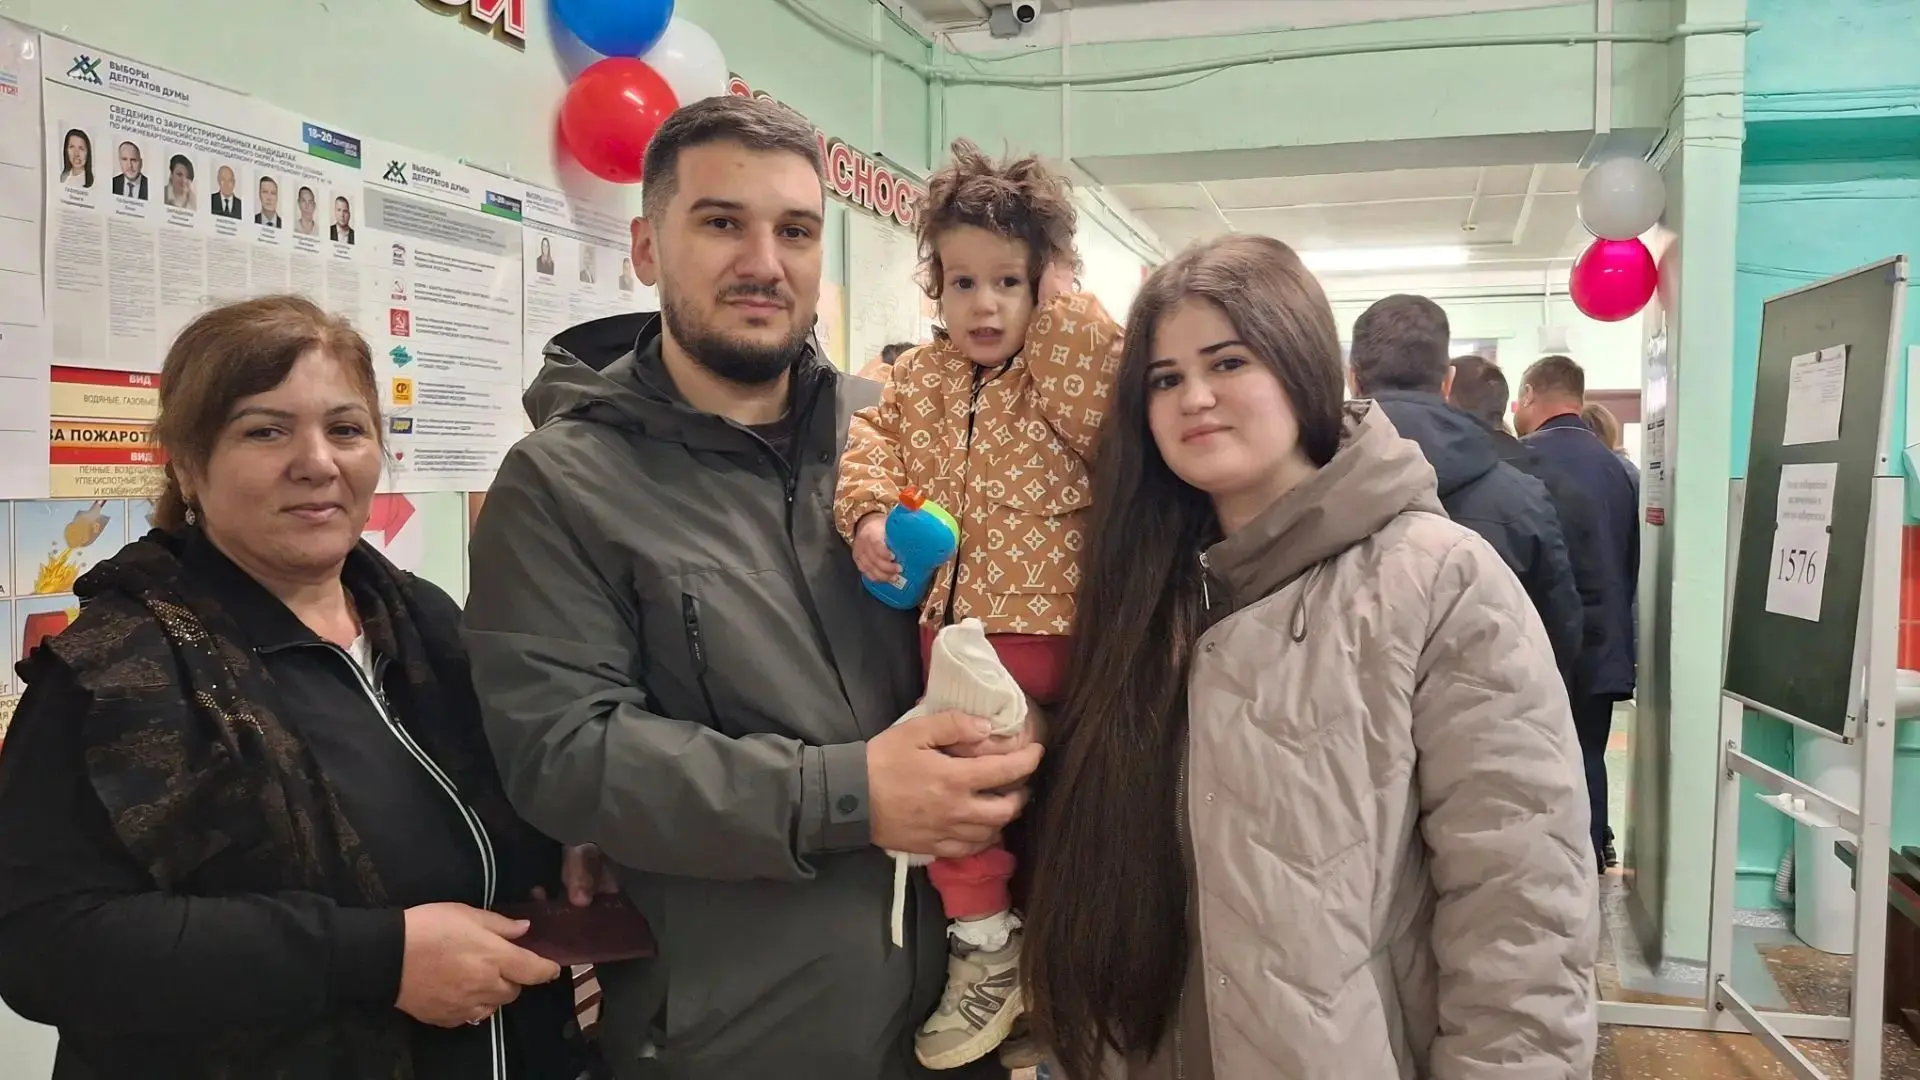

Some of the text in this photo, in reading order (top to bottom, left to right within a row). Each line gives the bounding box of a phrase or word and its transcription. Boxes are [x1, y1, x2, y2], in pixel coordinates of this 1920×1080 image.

[109, 61, 149, 79] ВЫБОРЫ
[109, 72, 161, 93] ДЕПУТАТОВ
[162, 87, 190, 101] ДУМЫ
[109, 104, 154, 122] СВЕДЕНИЯ
[156, 117, 163, 125] О
[252, 142, 297, 162] КАНДИДАТАХ
[412, 164, 441, 176] ВЫБОРЫ
[412, 172, 450, 189] ДЕПУТАТОВ
[450, 182, 470, 194] ДУМЫ
[128, 374, 152, 386] ВИД
[71, 429, 150, 443] ПОЖАРОТ
[130, 452, 153, 463] ВИД
[1777, 548, 1818, 585] 1576
